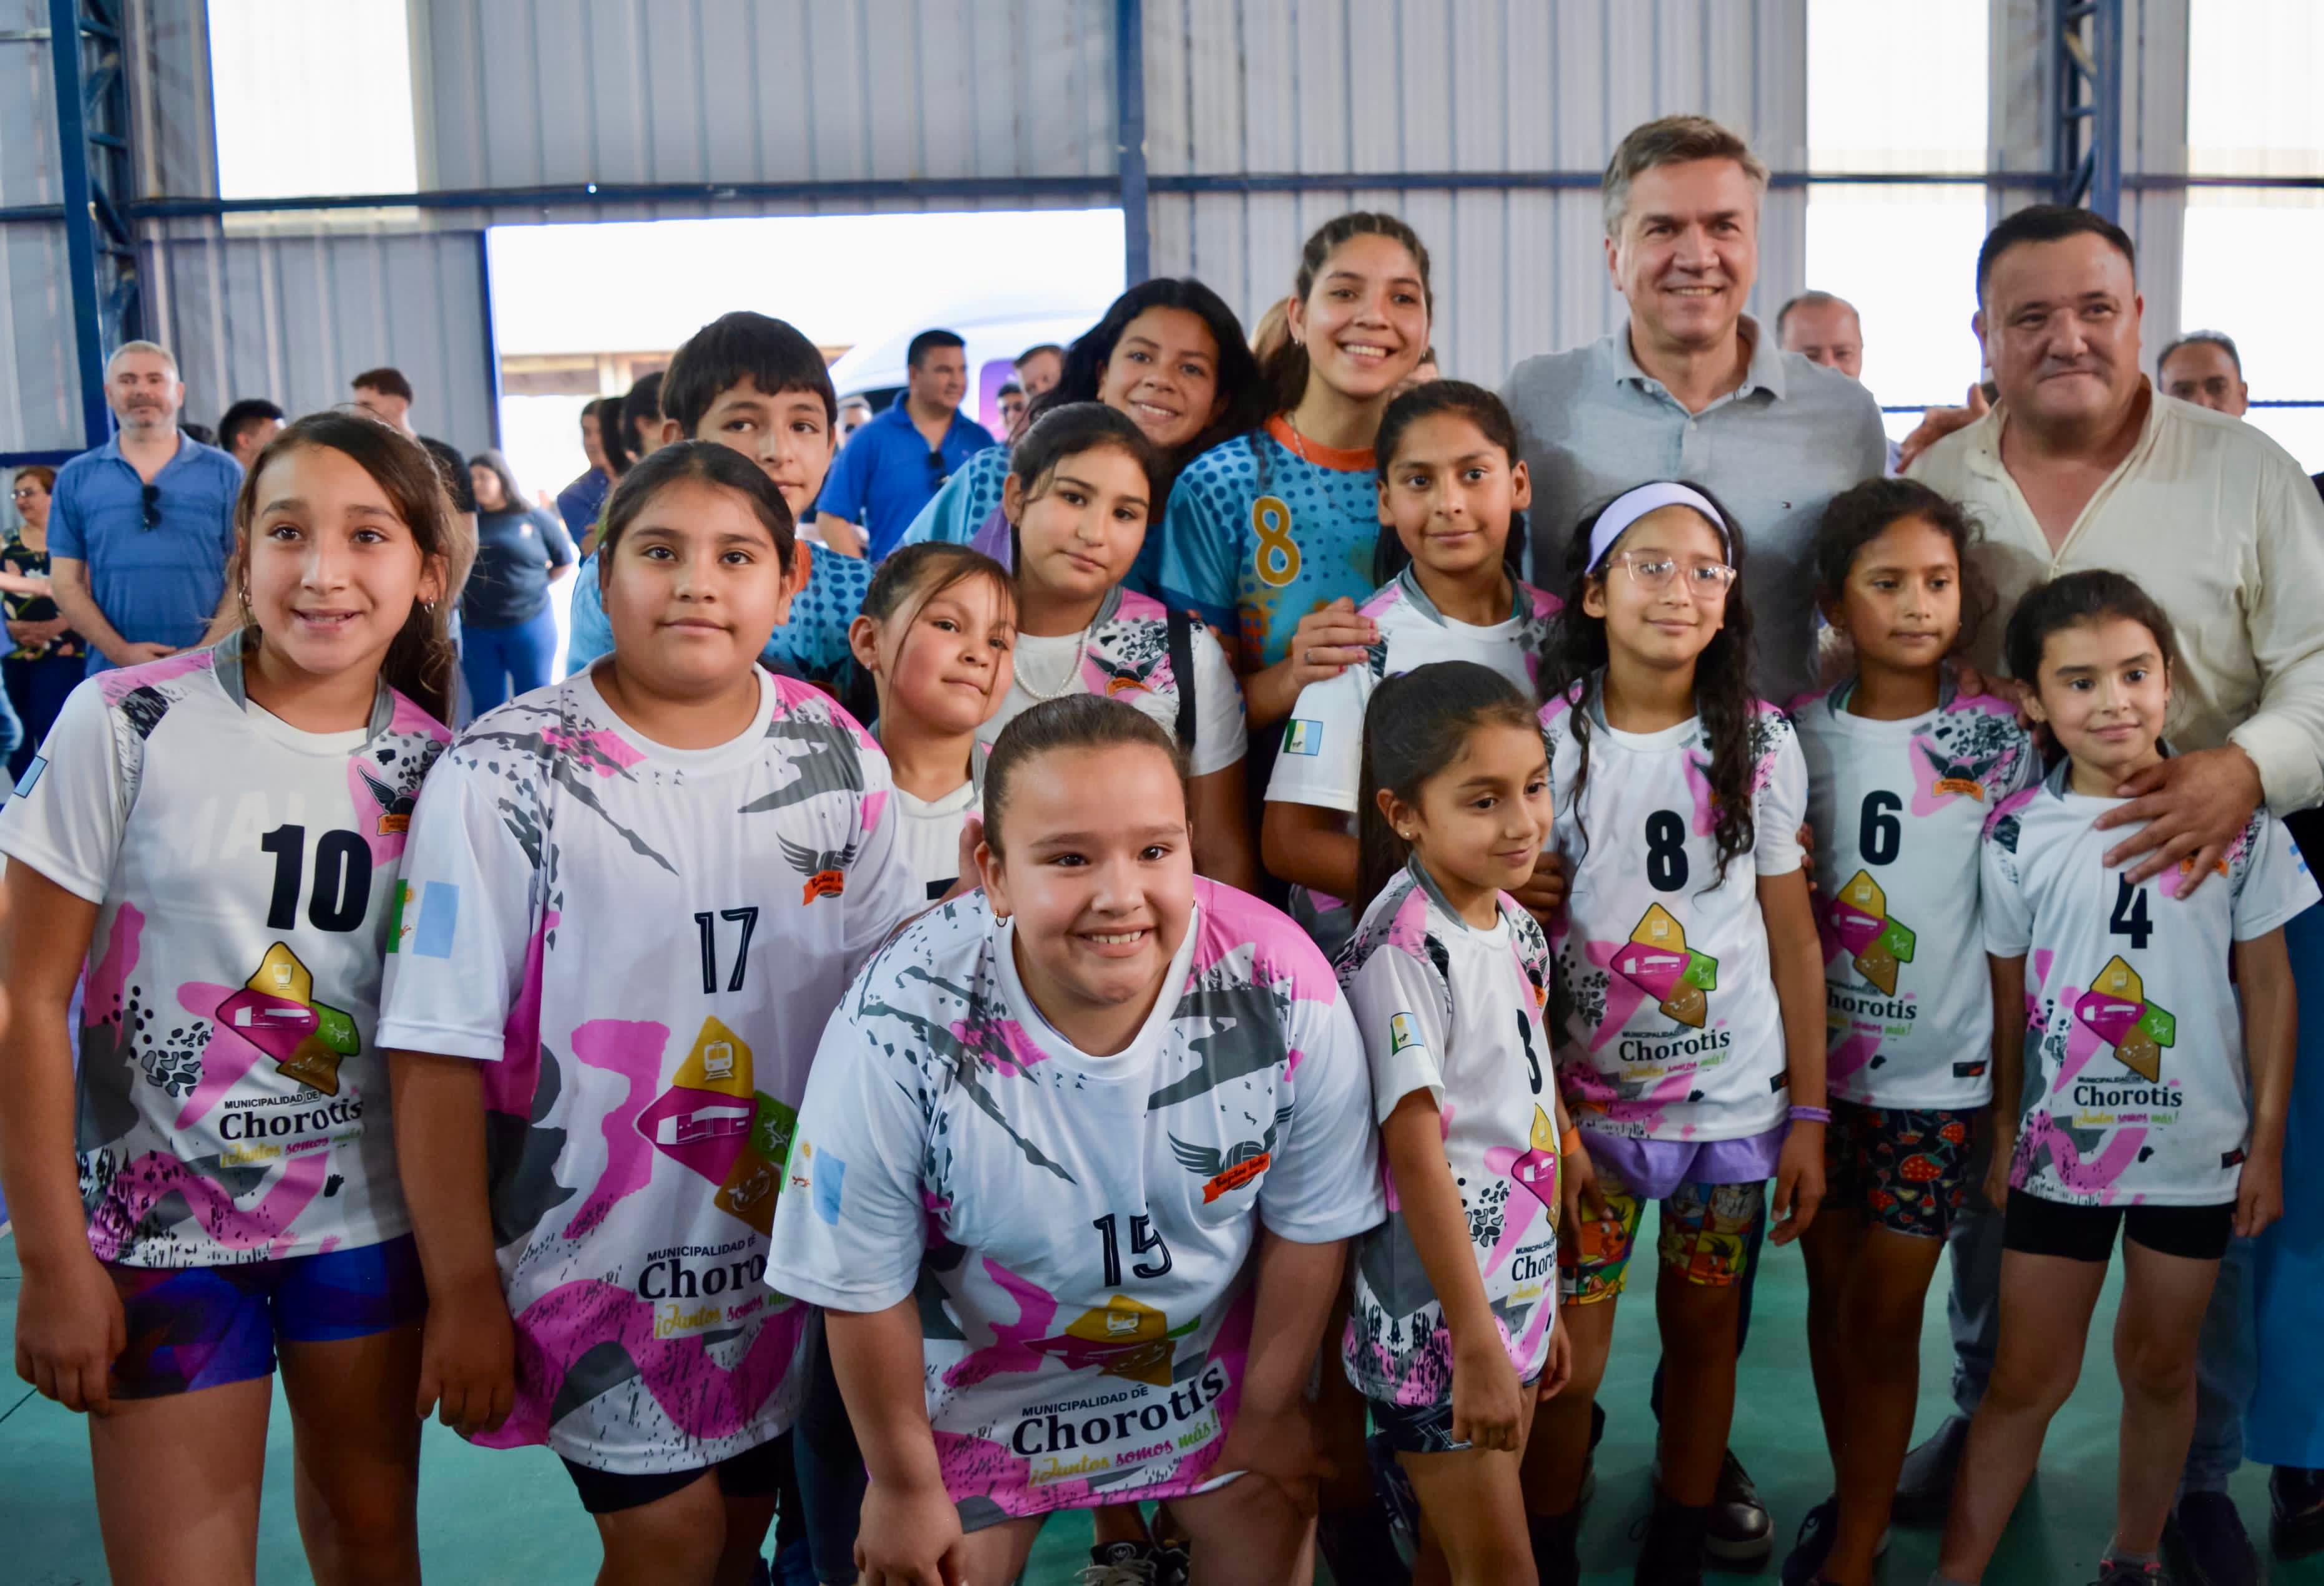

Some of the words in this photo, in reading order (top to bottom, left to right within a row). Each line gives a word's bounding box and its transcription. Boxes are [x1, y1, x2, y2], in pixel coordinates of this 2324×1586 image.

[1252, 495, 1302, 587] 8
[1859, 790, 1902, 865] 6
[1646, 809, 1688, 892] 8
[261, 824, 373, 932] 10
[2110, 872, 2152, 949] 4
[695, 906, 758, 994] 17
[1827, 987, 1917, 1019] horotis
[1619, 1029, 1731, 1061] Chorotis
[225, 1094, 303, 1109] MUNICIPALIDAD
[306, 1091, 320, 1101] DE
[2074, 1086, 2182, 1107] Chorotis
[220, 1098, 364, 1140] Chorotis
[285, 1137, 330, 1154] somos
[647, 1240, 745, 1262] MUNICIPALIDAD
[1093, 1202, 1172, 1287] 15
[1012, 1367, 1223, 1455] Chorotis
[1022, 1391, 1127, 1417] MUNICIPALIDAD
[1115, 1438, 1174, 1467] somos
